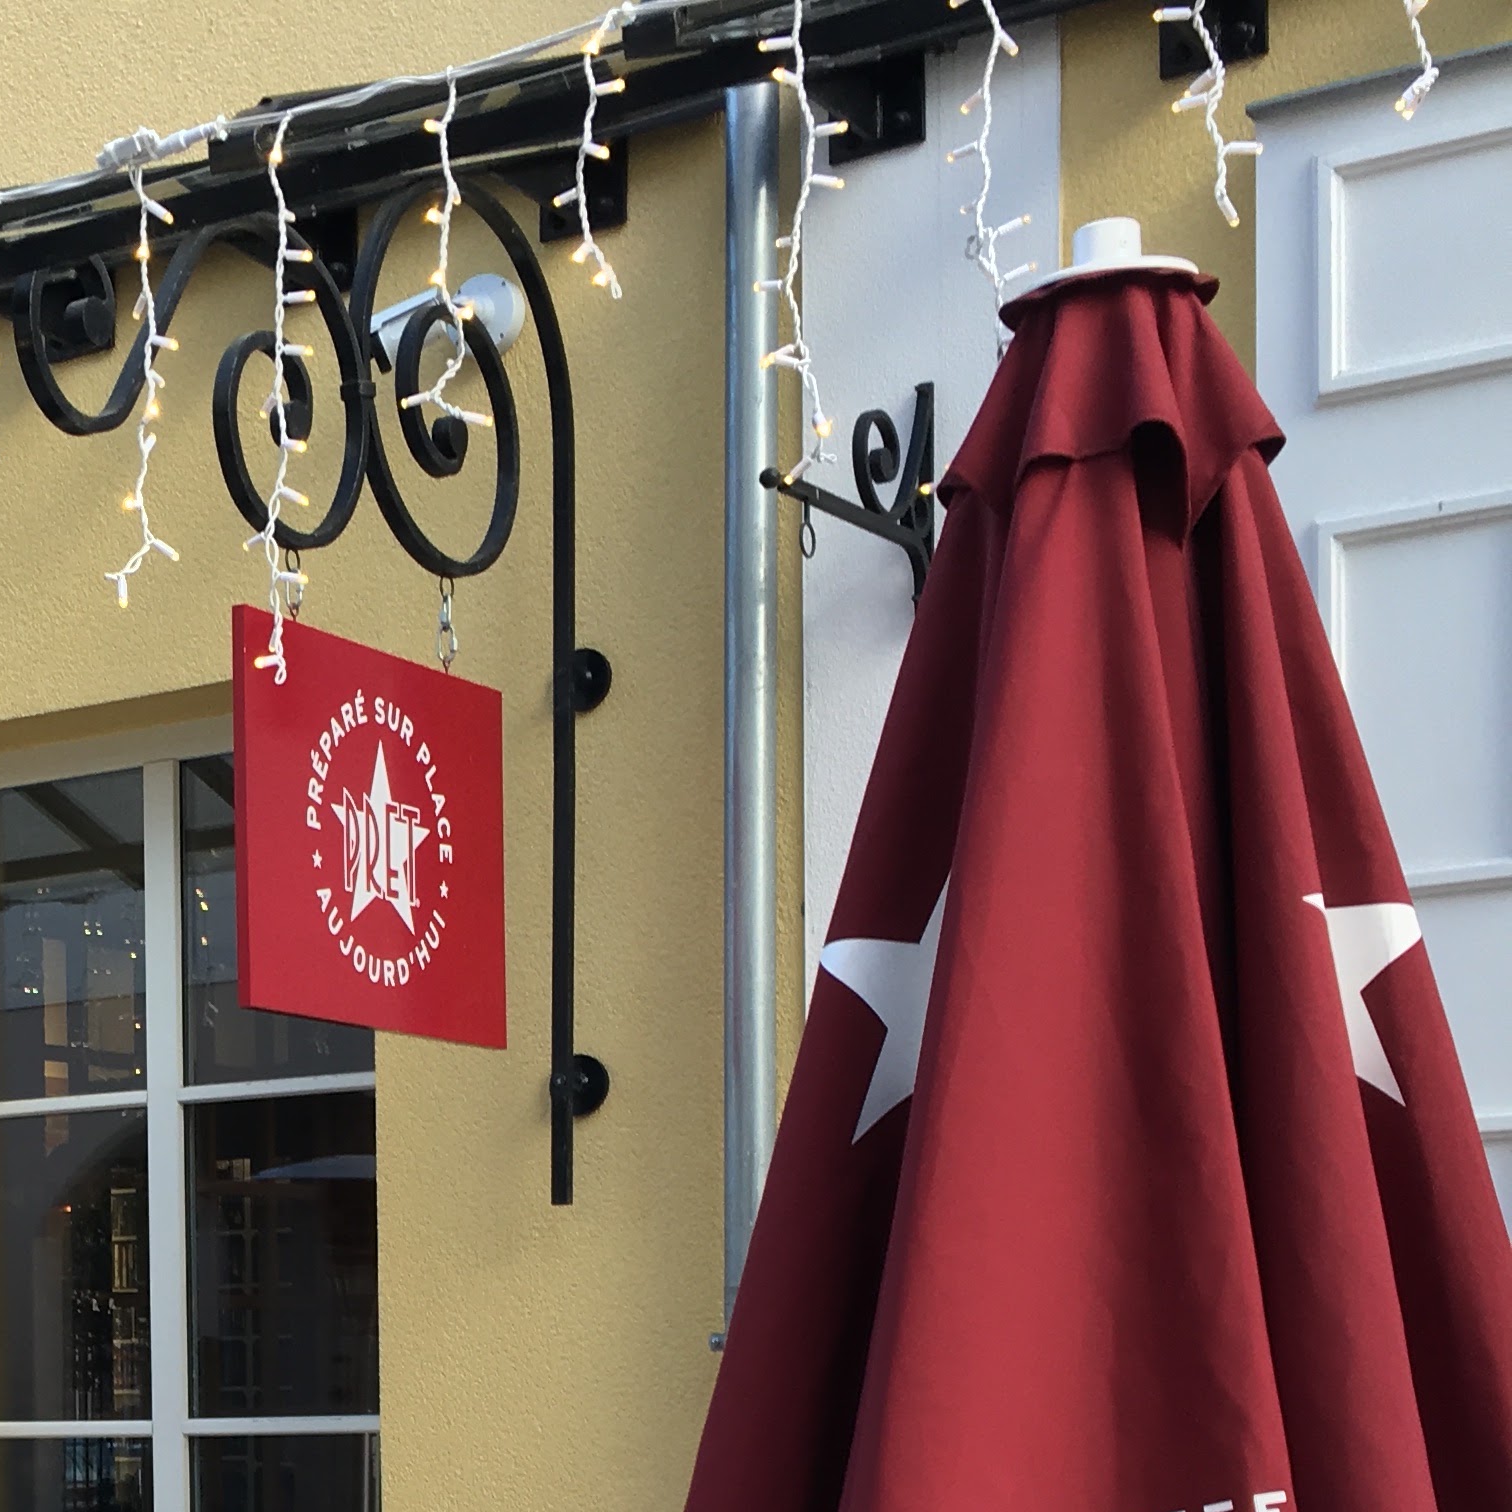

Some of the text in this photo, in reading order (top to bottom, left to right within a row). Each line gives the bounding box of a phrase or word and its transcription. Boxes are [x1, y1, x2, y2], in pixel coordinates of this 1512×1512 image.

[306, 688, 453, 866] PRÉPARÉ SUR PLACE
[343, 787, 421, 907] PRET
[316, 886, 446, 987] AUJOURD'HUI
